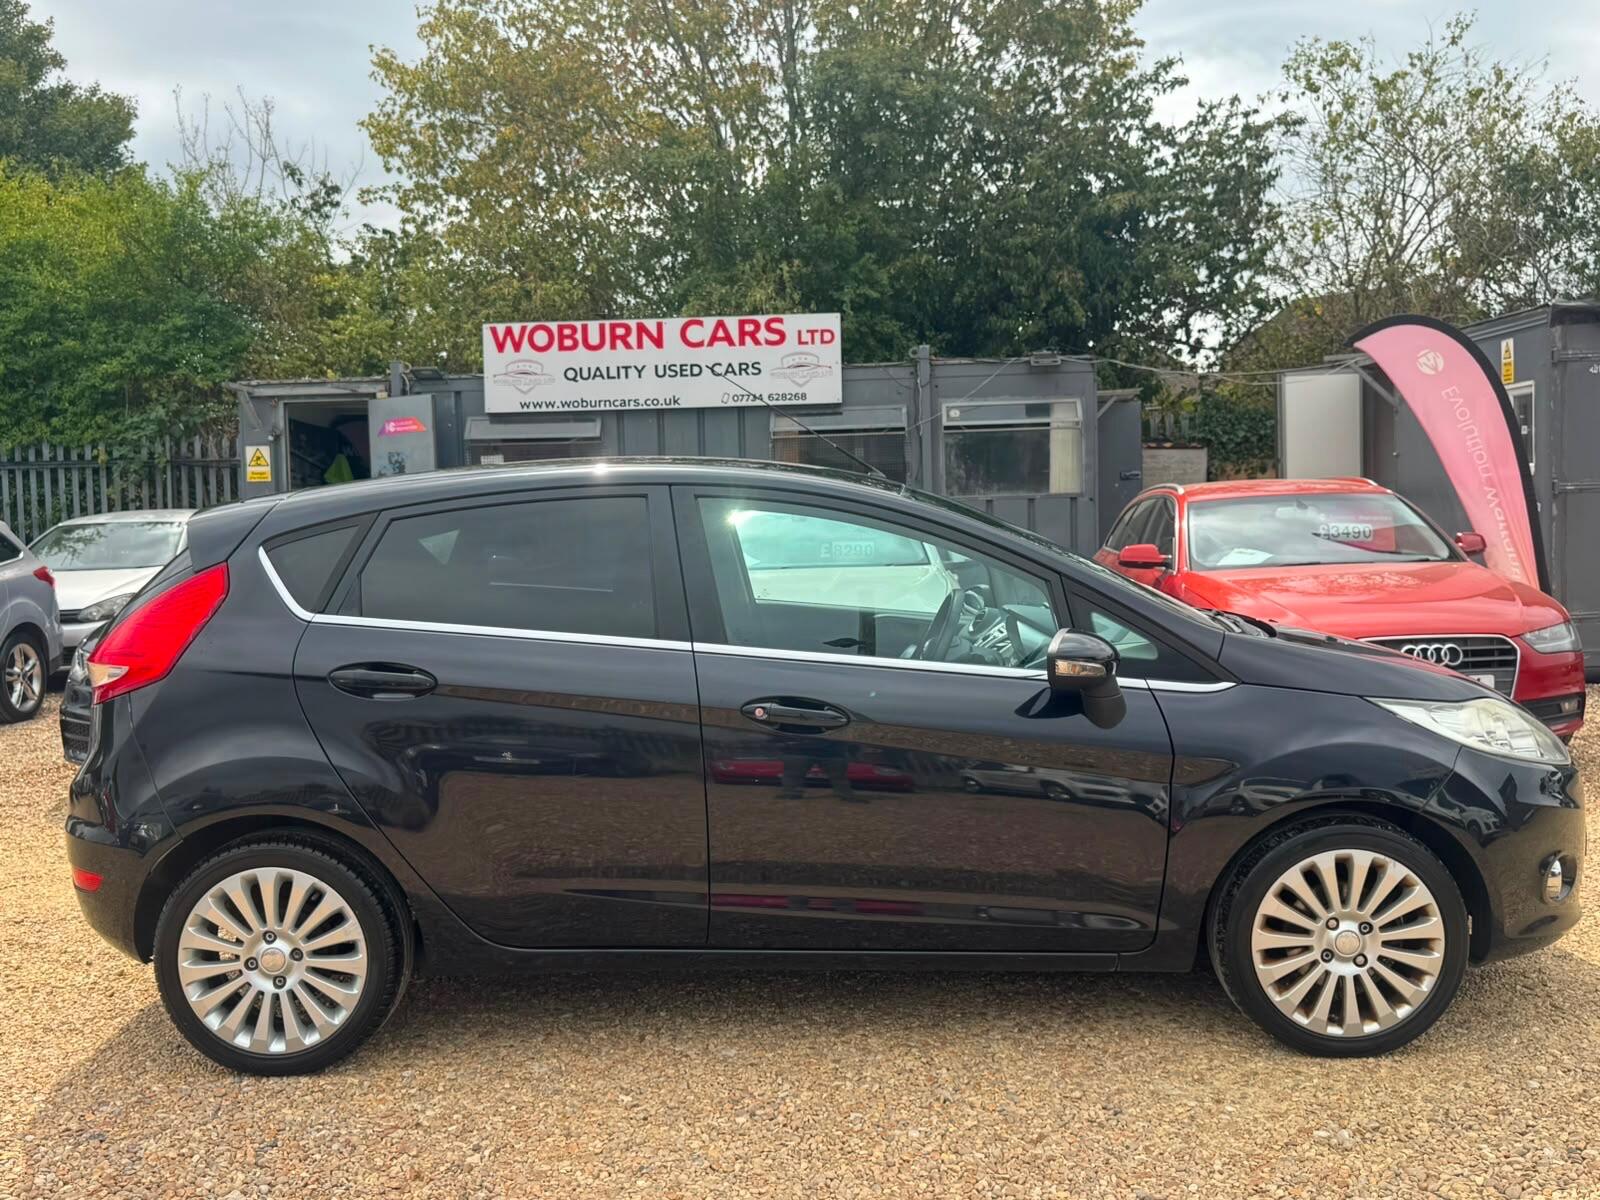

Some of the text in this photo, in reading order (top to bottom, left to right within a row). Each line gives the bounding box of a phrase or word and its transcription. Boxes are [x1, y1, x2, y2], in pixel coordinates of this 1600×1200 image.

[489, 317, 835, 353] WOBURN CARS LTD
[563, 365, 646, 382] QUALITY
[654, 364, 703, 378] USED
[711, 362, 762, 376] CARS
[520, 395, 680, 409] www.woburncars.co.uk
[768, 392, 807, 401] 628268
